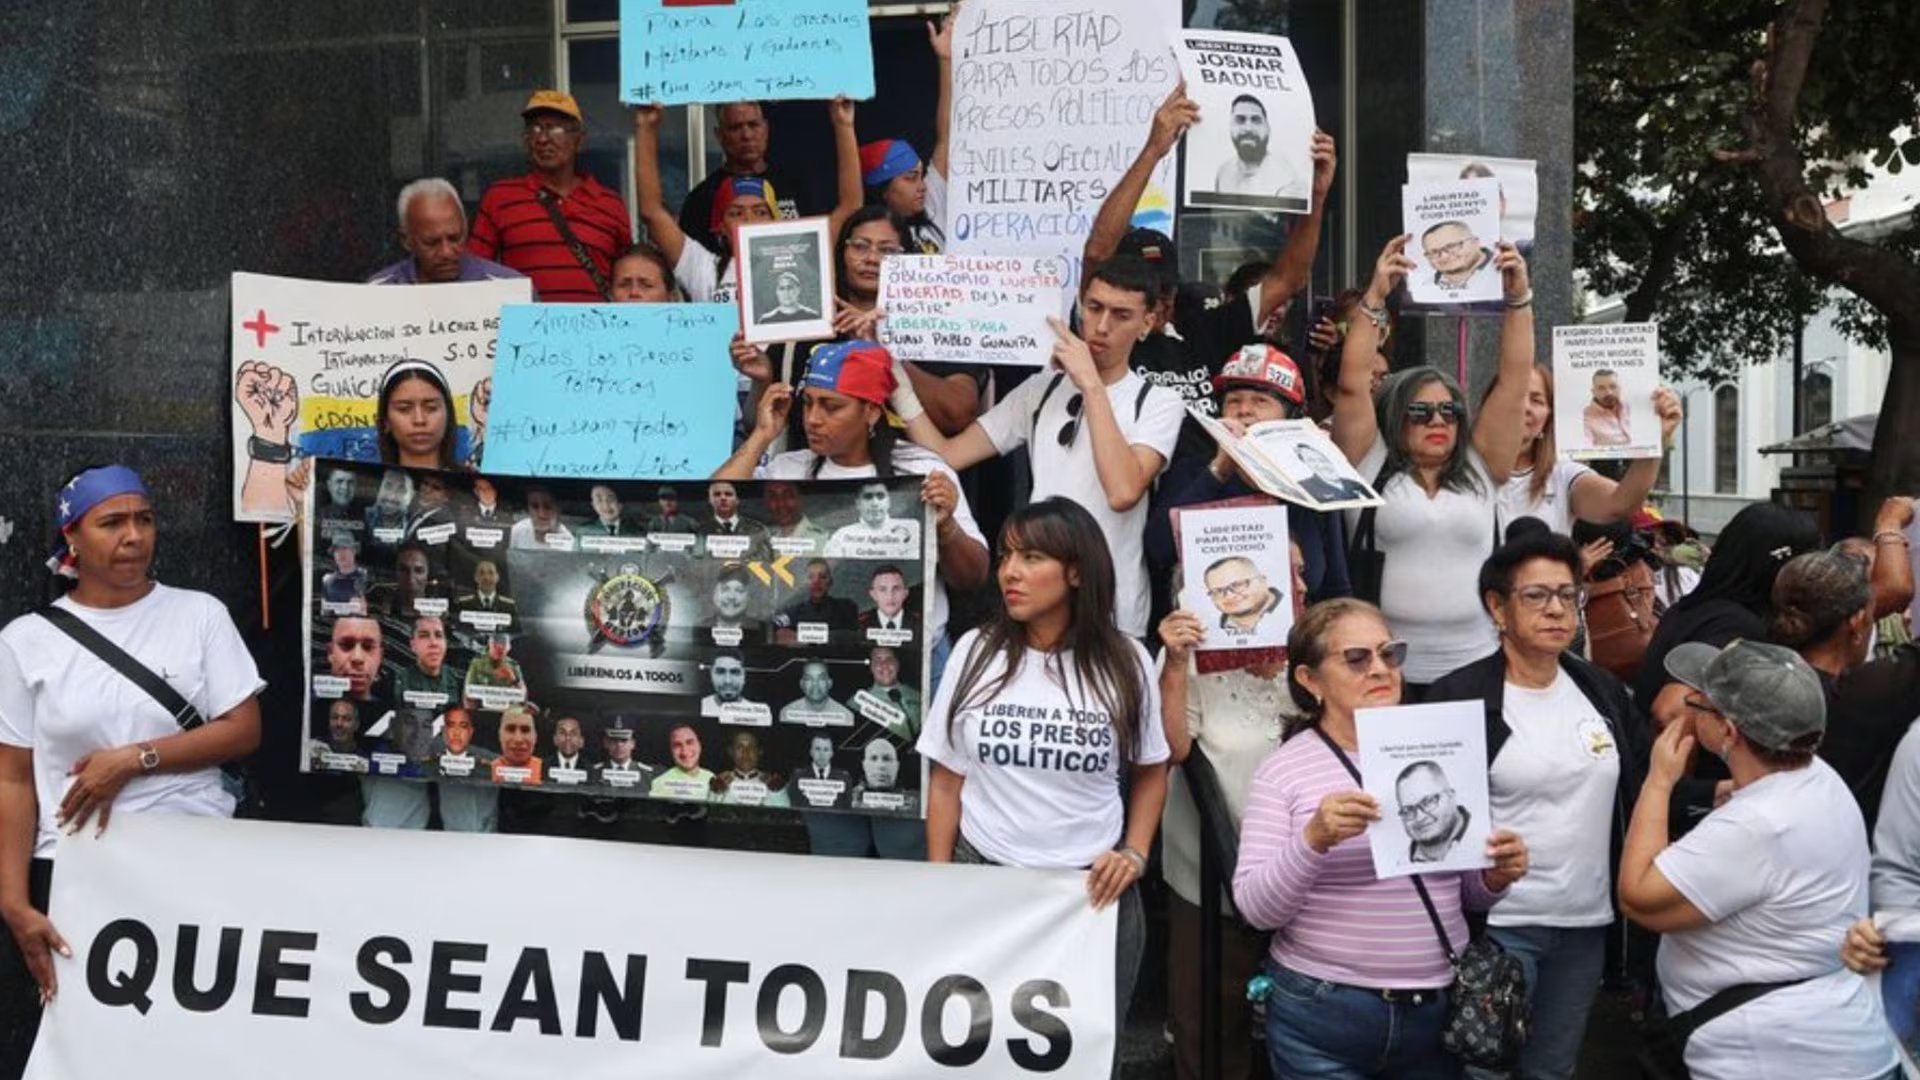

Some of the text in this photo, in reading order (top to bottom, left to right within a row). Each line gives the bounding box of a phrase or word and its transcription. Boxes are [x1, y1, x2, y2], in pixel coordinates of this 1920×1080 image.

[964, 9, 1121, 57] LIBERTAD
[1197, 53, 1284, 73] JOSNAR
[955, 60, 1018, 97] PARA
[1023, 57, 1109, 86] TODOS
[1201, 68, 1292, 91] BADUEL
[953, 95, 1046, 133] PRESOS
[952, 139, 1036, 177] CIVILES
[1043, 139, 1136, 174] OFICIALE
[967, 178, 1108, 211] MILITARES
[1423, 191, 1479, 202] LIBERTAD
[1415, 199, 1488, 212] PARA DENYS
[945, 254, 1022, 272] SILENCIO
[888, 271, 990, 284] OBLIGATORIO
[971, 290, 1009, 307] DEJA
[1018, 293, 1036, 304] DE
[885, 317, 1009, 333] LIBERTAD PARA
[1556, 325, 1655, 337] EXIGIMOS LIBERTAD
[881, 331, 1038, 349] JUAN PABLO GUANIPA
[1565, 336, 1647, 346] INMEDIATA PARA
[1569, 349, 1645, 360] VICTOR MIGUEL
[1203, 524, 1264, 534] LIBERTAD
[1195, 533, 1274, 544] PARA DENYS
[634, 671, 643, 681] A
[645, 671, 684, 684] TODOS
[983, 703, 1113, 725] LIBEREN A TODO
[980, 719, 1111, 747] LOS PRESOS
[978, 740, 1110, 774] POLÍTICOS
[86, 918, 1073, 1073] QUE SEAN TODOS
